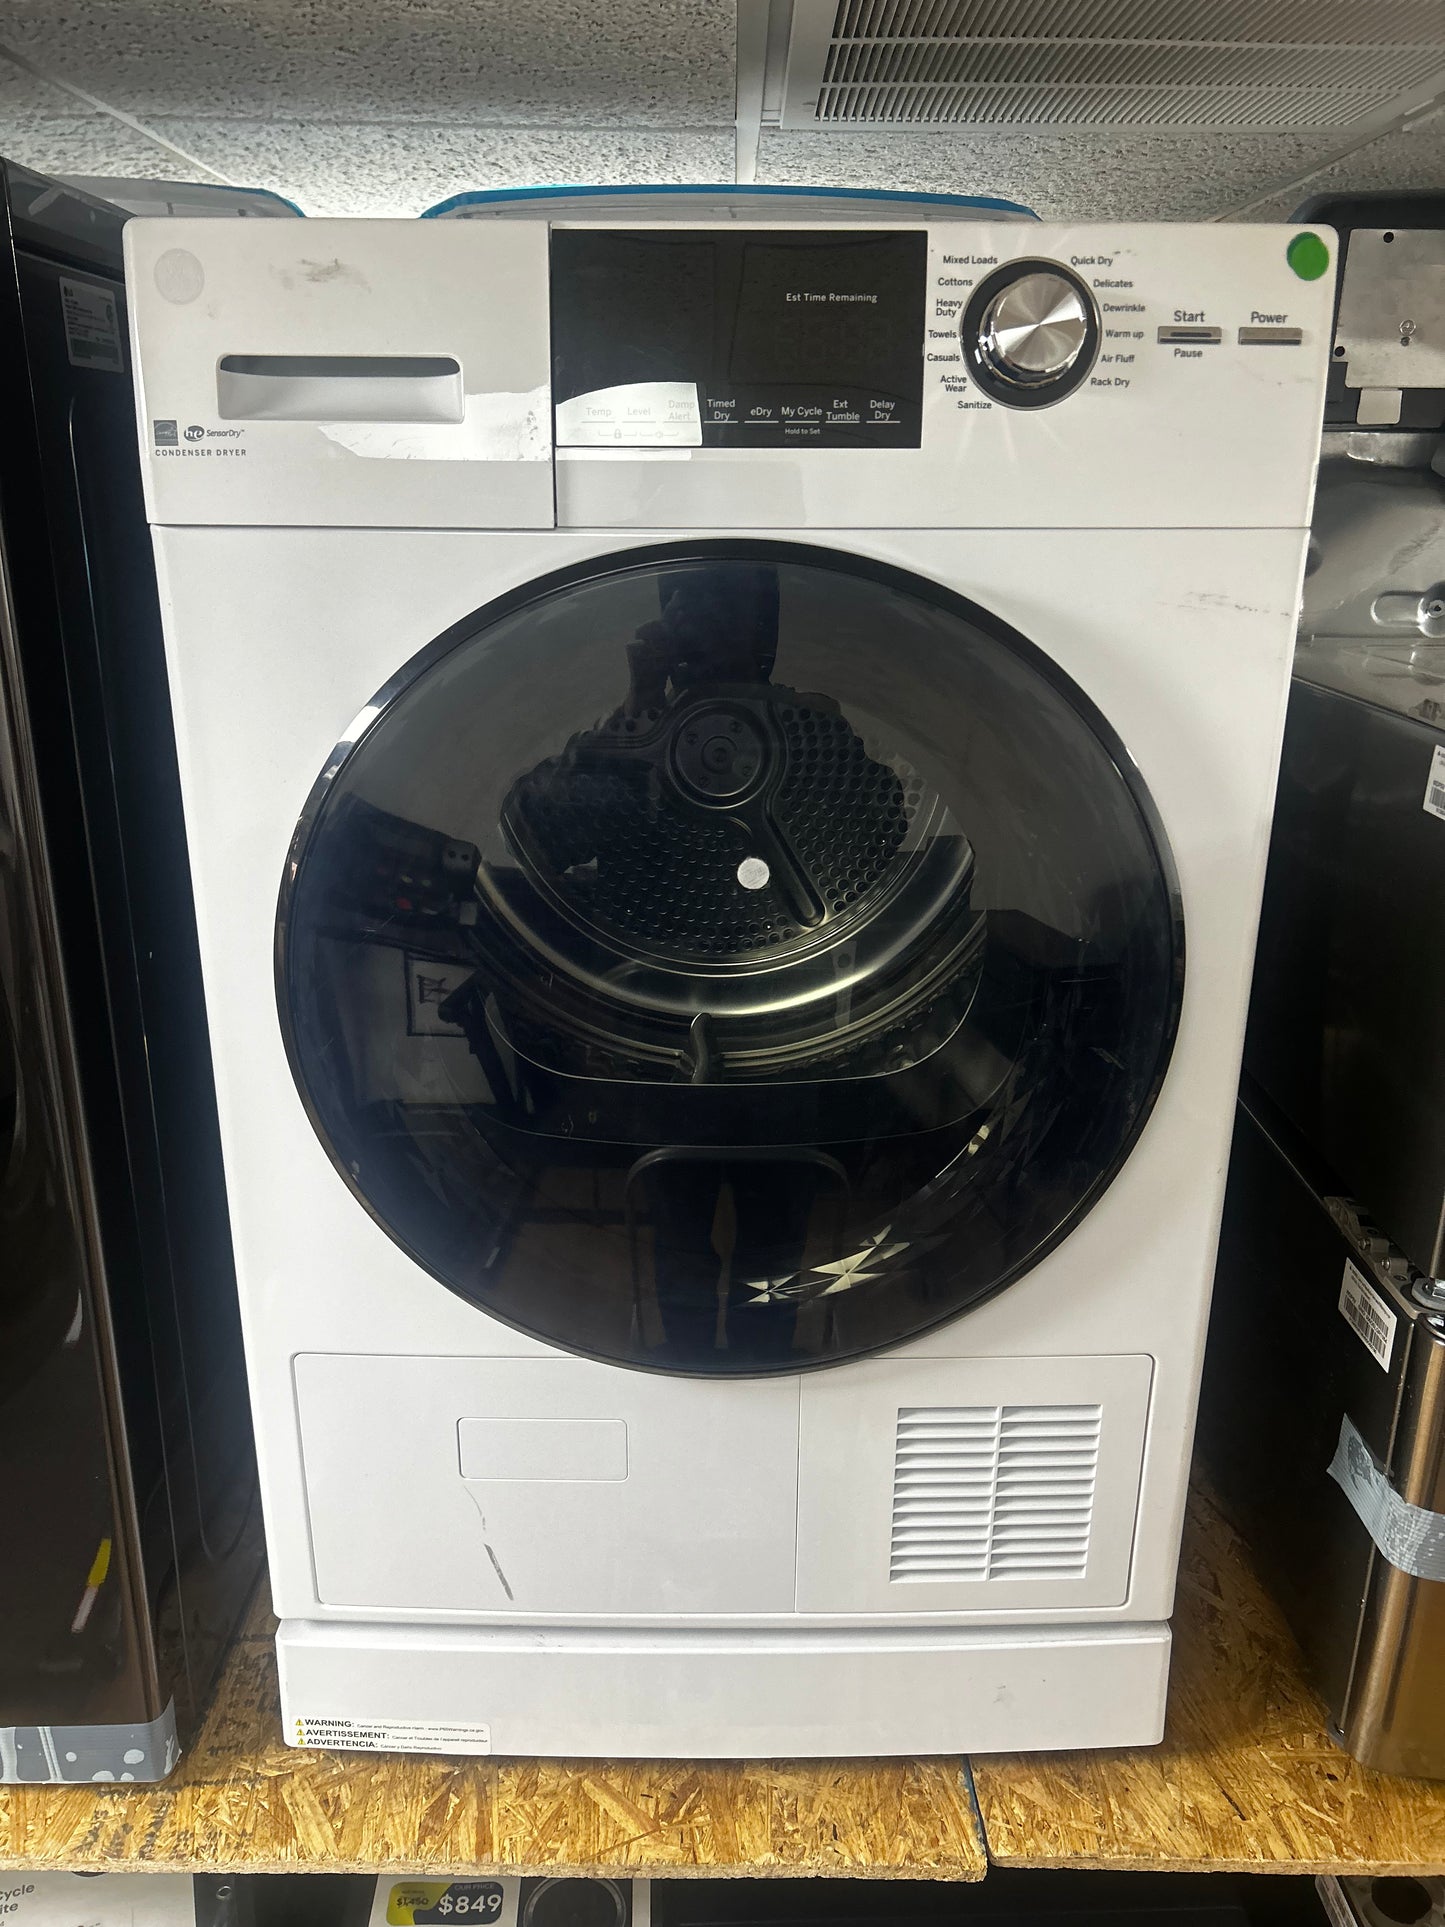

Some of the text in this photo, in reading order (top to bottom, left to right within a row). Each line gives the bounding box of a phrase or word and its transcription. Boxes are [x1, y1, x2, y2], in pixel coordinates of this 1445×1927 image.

[943, 255, 998, 264] Mixed Loads
[1071, 256, 1113, 267] Quick Dry
[938, 277, 973, 286] Cottons
[1093, 279, 1133, 288] Delicates
[786, 293, 878, 304] Est Time Remaining
[936, 299, 963, 309] Heavy
[1103, 303, 1145, 312] Dewrinkle
[936, 308, 957, 318] Duty
[1174, 310, 1205, 322] Start
[1251, 311, 1288, 323] Power
[928, 330, 957, 339] Towels
[1105, 329, 1144, 339] Warm up
[927, 353, 960, 361] Casuals
[1174, 348, 1203, 358] Pause
[1101, 354, 1135, 363] Air Fluff
[940, 375, 967, 383] Active
[1091, 378, 1130, 388] Rack Dry
[945, 384, 967, 392] Wear
[668, 400, 695, 409] Damp
[706, 399, 736, 408] Timed
[833, 400, 848, 409] Ext
[870, 400, 896, 411] Delay
[957, 401, 992, 409] Sanitize
[586, 408, 612, 417] Temp
[627, 408, 651, 416] Level
[714, 411, 731, 421] Dry
[750, 407, 772, 418] eDry
[781, 407, 823, 417] My Cycle
[826, 411, 860, 421] Tumble
[874, 410, 891, 421] Dry
[668, 413, 691, 421] Alert
[155, 449, 247, 457] CONDENSER DRYER
[304, 1719, 355, 1728] WARNING:
[306, 1729, 390, 1739] AVERTISSEMENT:
[306, 1738, 378, 1749] ADVERTENCIA:
[438, 1893, 502, 1915] $849
